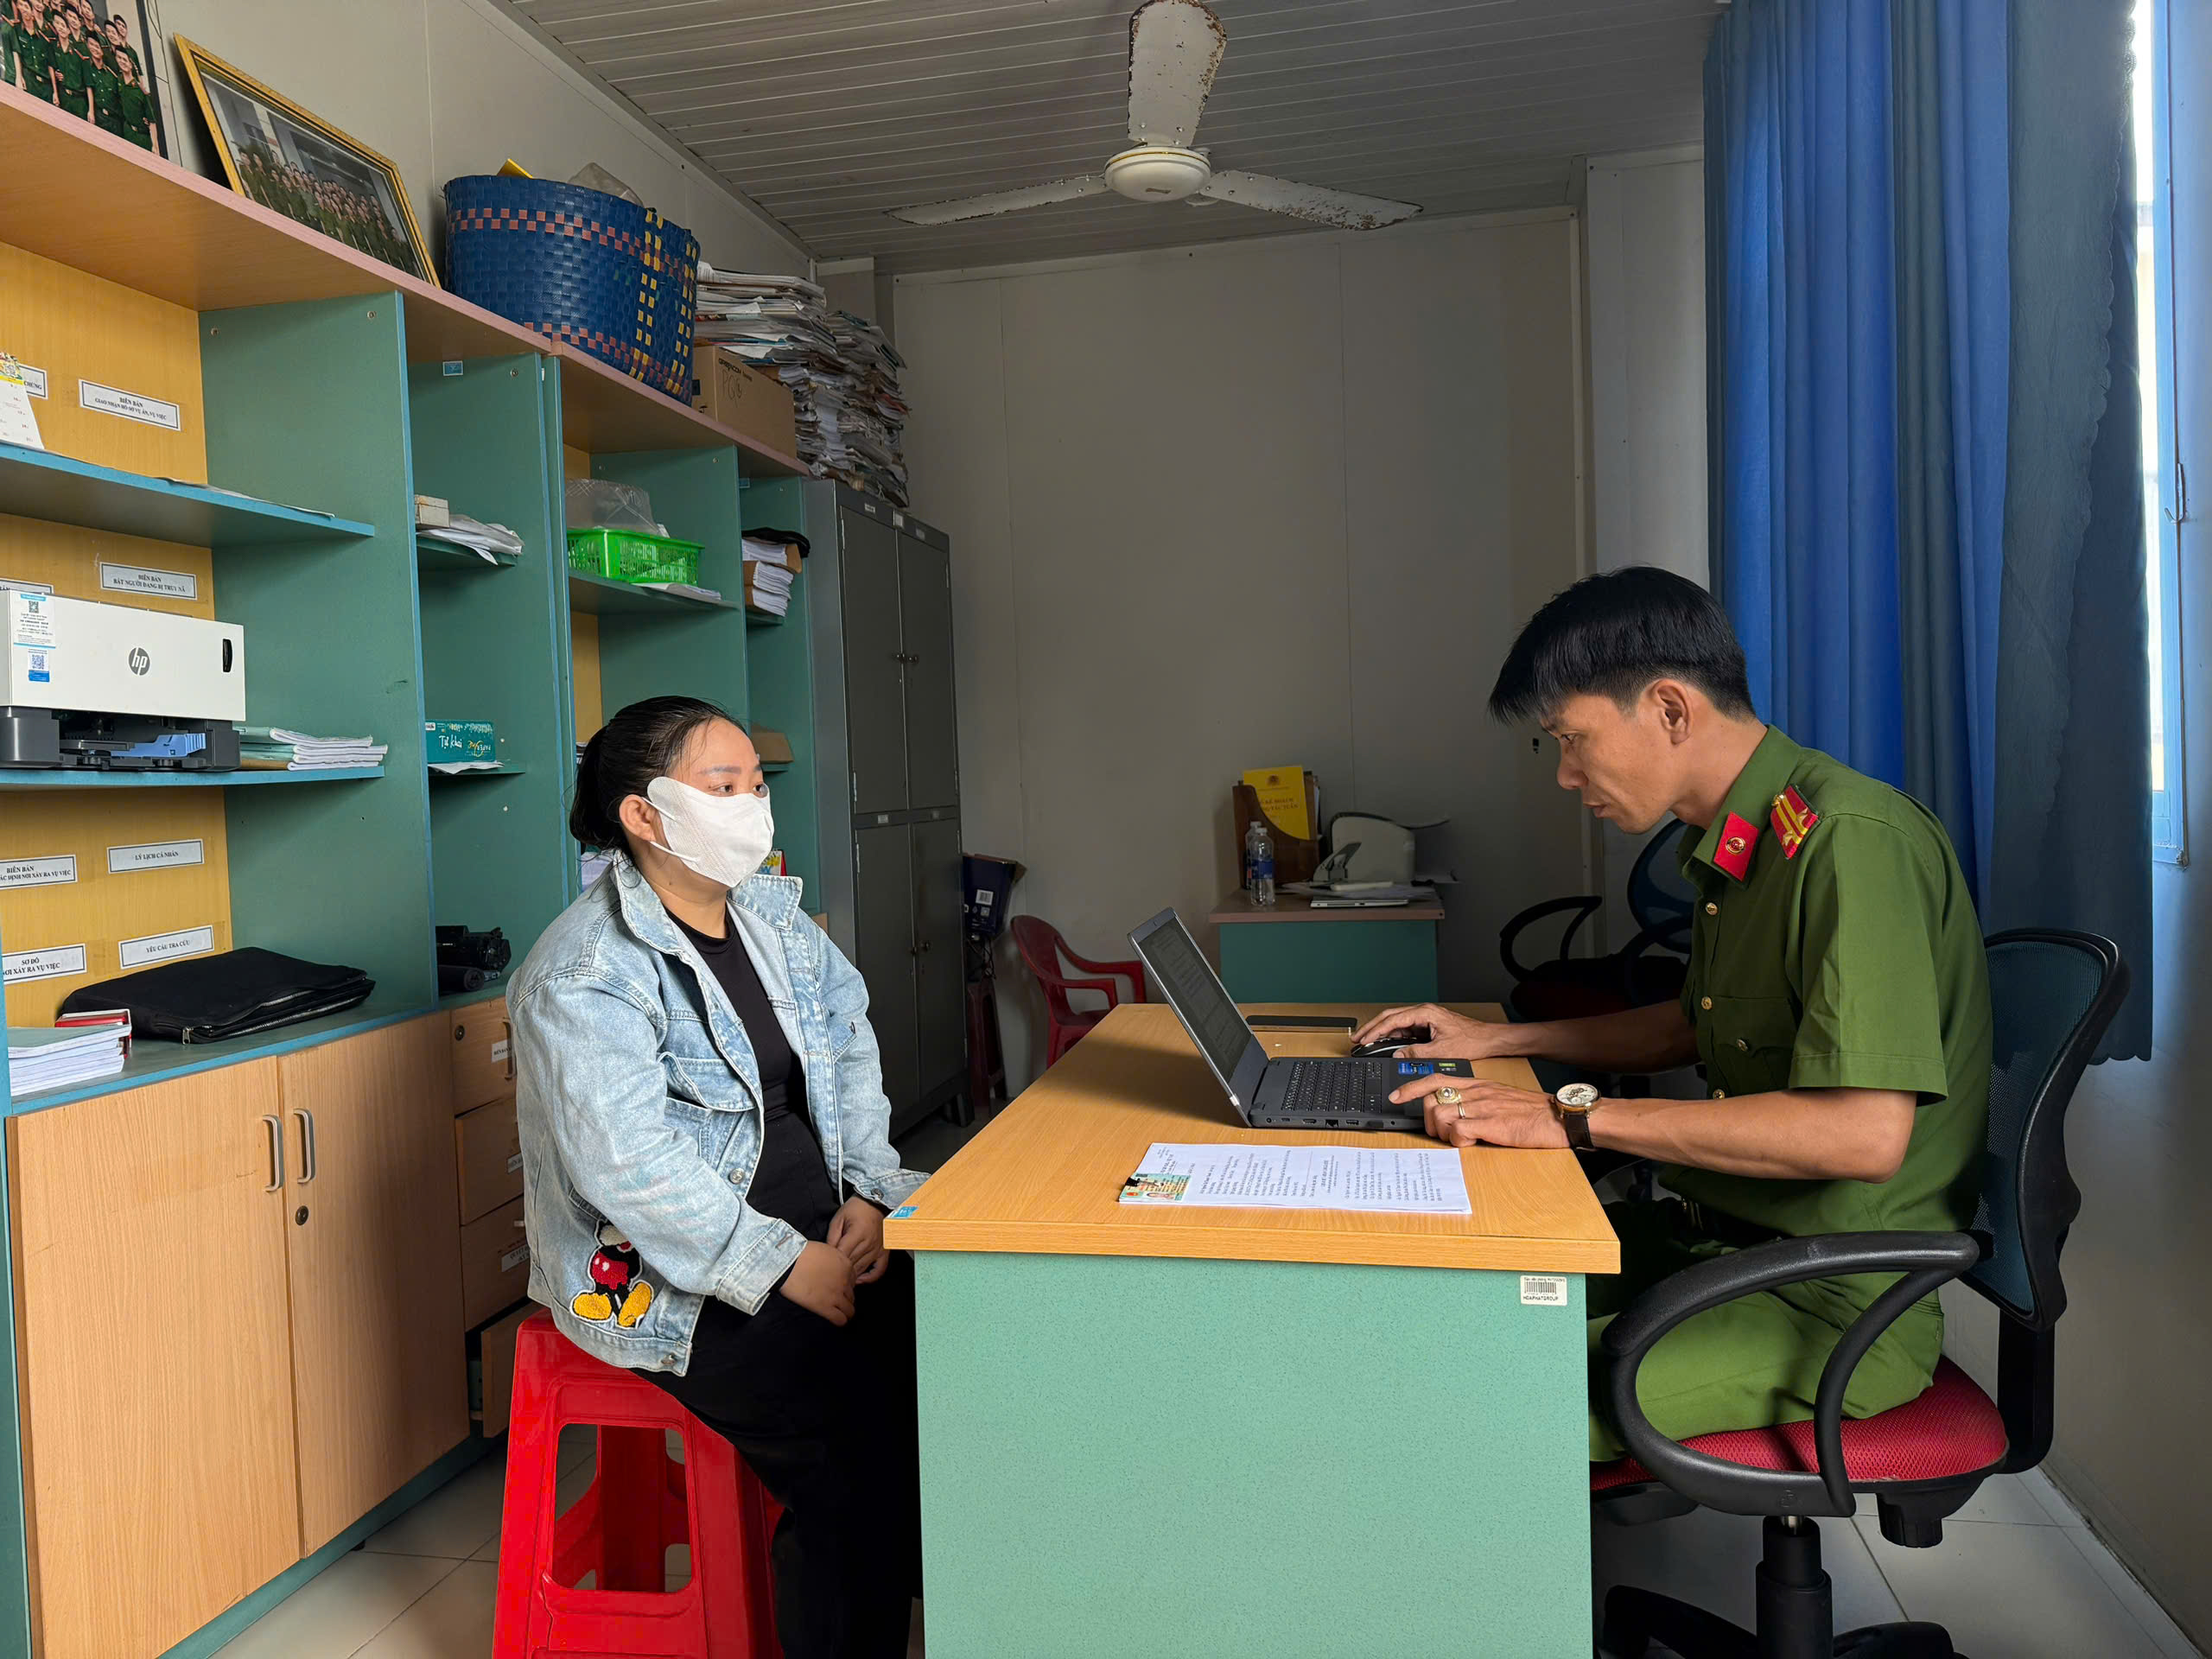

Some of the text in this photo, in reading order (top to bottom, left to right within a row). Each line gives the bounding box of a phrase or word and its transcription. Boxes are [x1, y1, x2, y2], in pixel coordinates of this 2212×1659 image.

[130, 647, 148, 676] hp
[7, 864, 35, 874] BIÊN BẢN
[46, 962, 60, 970] VIỆC
